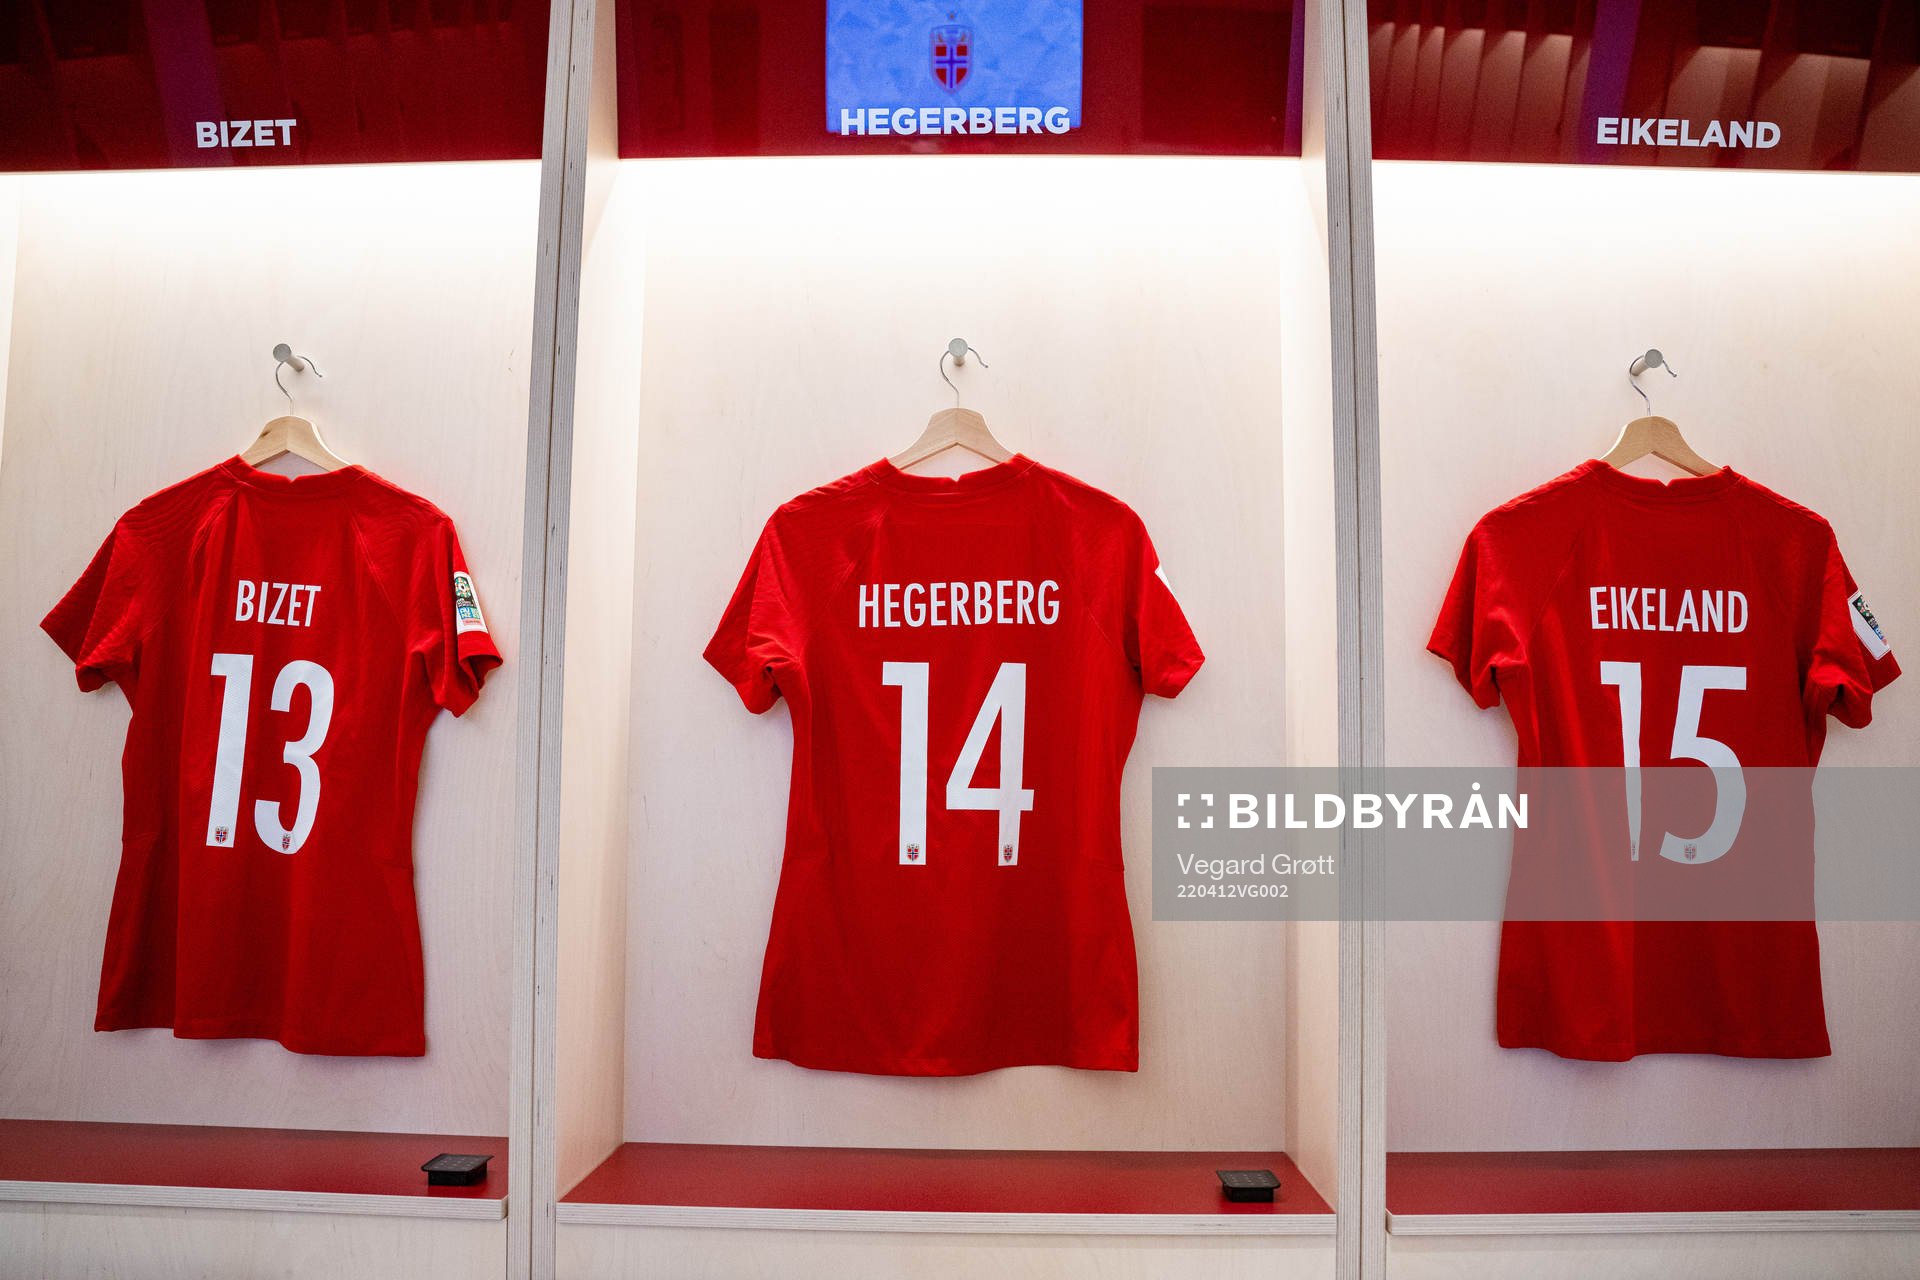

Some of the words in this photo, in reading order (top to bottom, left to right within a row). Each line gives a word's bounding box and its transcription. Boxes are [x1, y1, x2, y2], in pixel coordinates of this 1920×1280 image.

[195, 118, 297, 149] BIZET
[841, 107, 1071, 136] HEGERBERG
[1596, 116, 1781, 149] EIKELAND
[235, 579, 322, 628] BIZET
[858, 579, 1060, 629] HEGERBERG
[1589, 586, 1749, 634] EIKELAND
[205, 652, 335, 855] 13
[881, 661, 1035, 867] 14
[1599, 660, 1748, 865] 15
